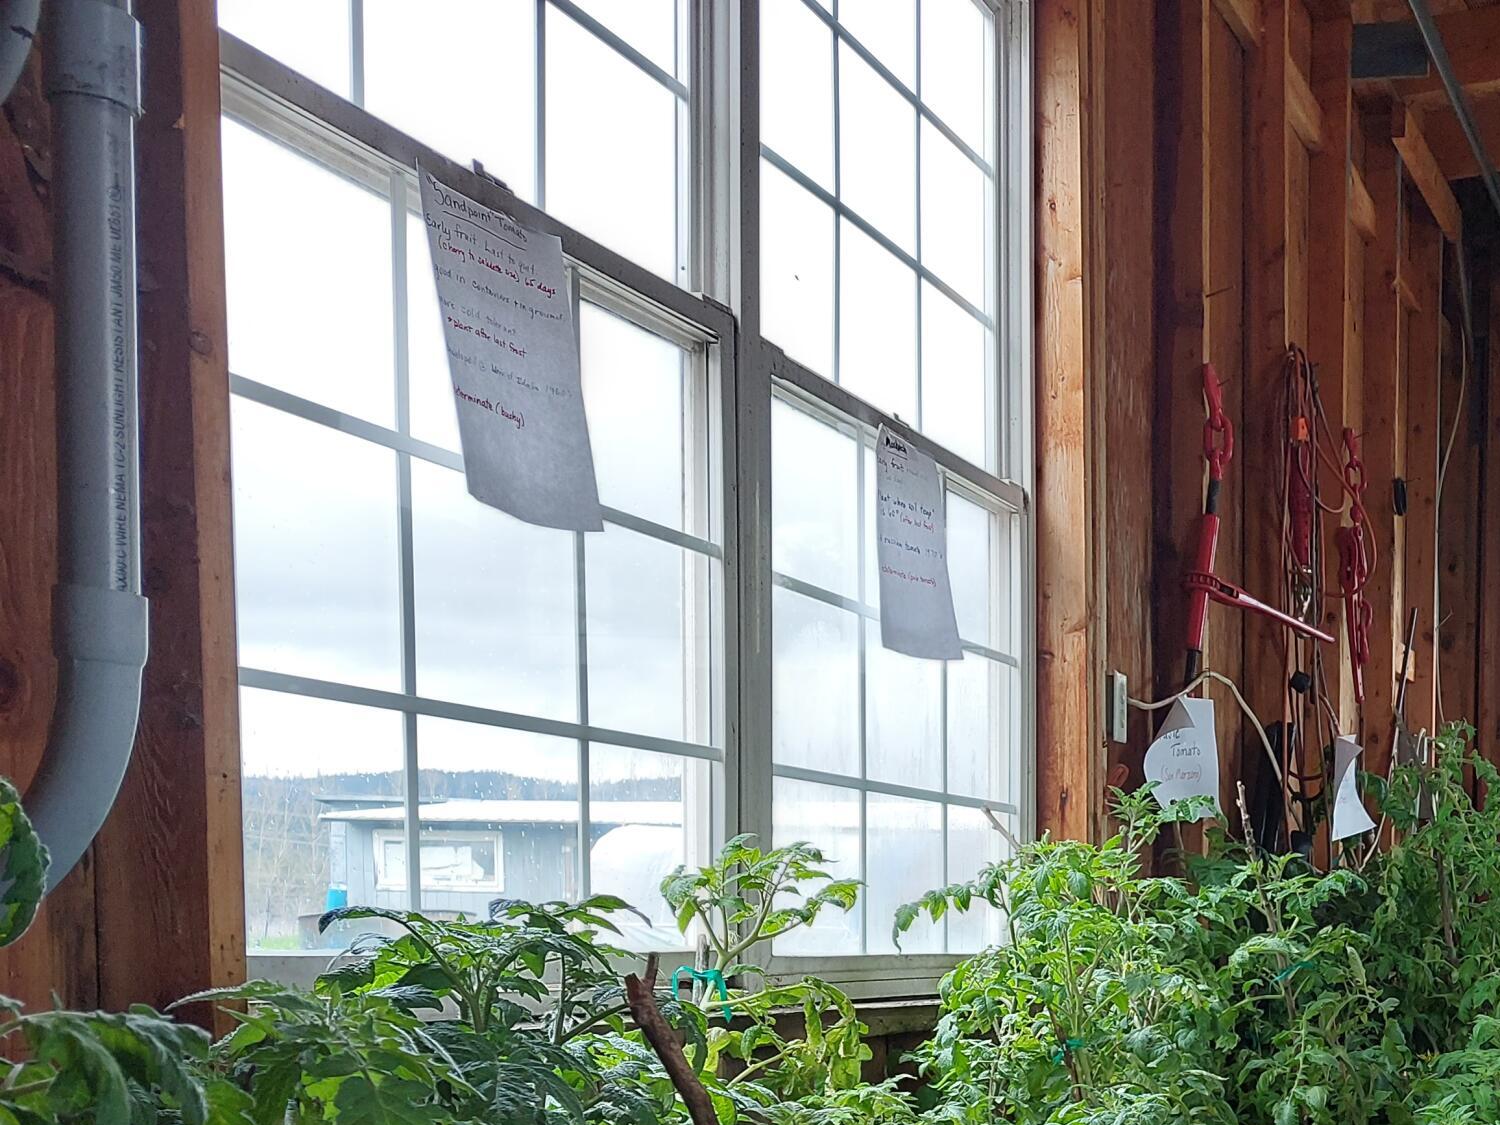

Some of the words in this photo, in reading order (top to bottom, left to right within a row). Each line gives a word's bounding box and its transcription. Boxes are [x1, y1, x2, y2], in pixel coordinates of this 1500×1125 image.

[426, 213, 451, 241] Early
[537, 283, 556, 299] days
[110, 302, 125, 373] RESISTANT
[112, 377, 126, 438] SUNLIGHT
[114, 474, 127, 512] NEMA
[114, 515, 127, 546] WIRE
[1170, 741, 1201, 757] Tomato
